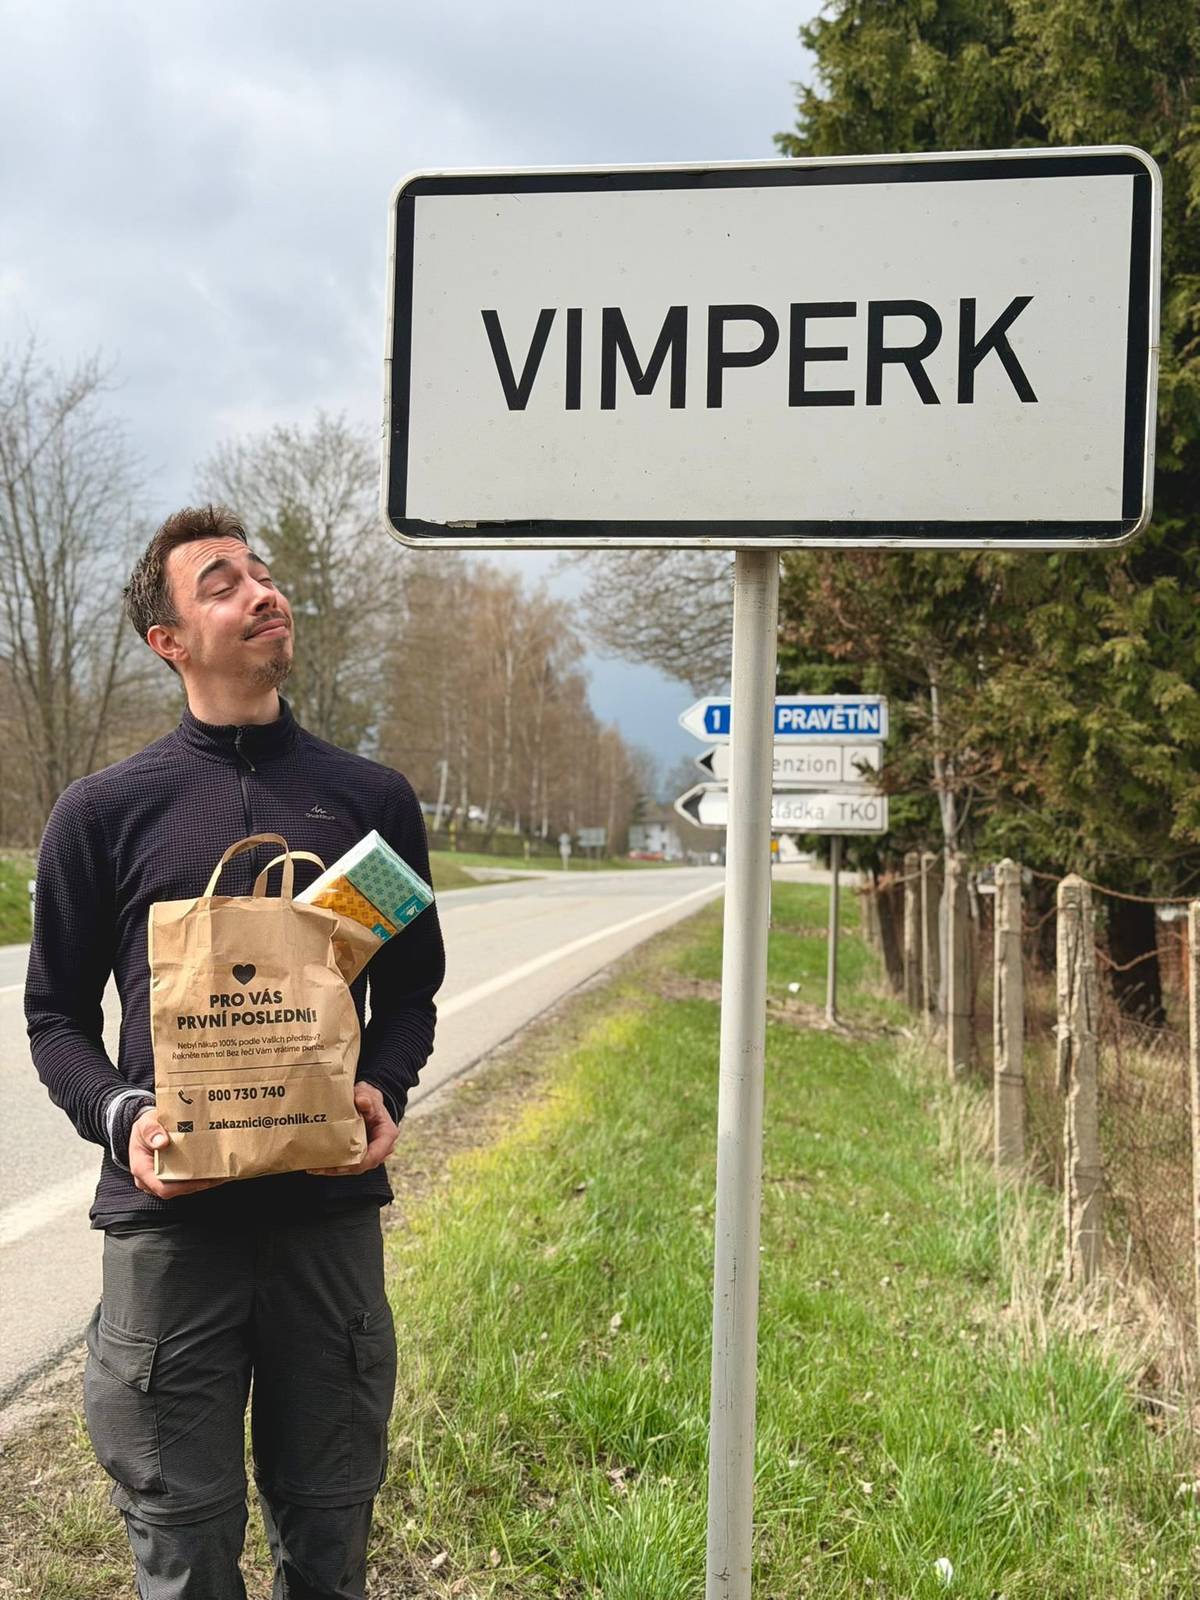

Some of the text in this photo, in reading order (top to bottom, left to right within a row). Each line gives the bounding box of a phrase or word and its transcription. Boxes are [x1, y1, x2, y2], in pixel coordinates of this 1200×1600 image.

[480, 295, 1039, 411] VIMPERK
[712, 705, 879, 730] 1 PRAVĚTÍN
[773, 754, 837, 773] enzion
[772, 800, 825, 820] ládka
[210, 988, 283, 1008] PRO VÁS
[177, 1008, 317, 1030] PRVNÍ POSLEDNÍ!
[219, 1039, 237, 1047] 100%
[238, 1037, 261, 1047] podle
[216, 1050, 225, 1058] to!
[255, 1047, 272, 1055] Vám
[207, 1085, 286, 1102] 800 730 740
[208, 1112, 327, 1130] zakaznici@rohlik.cz
